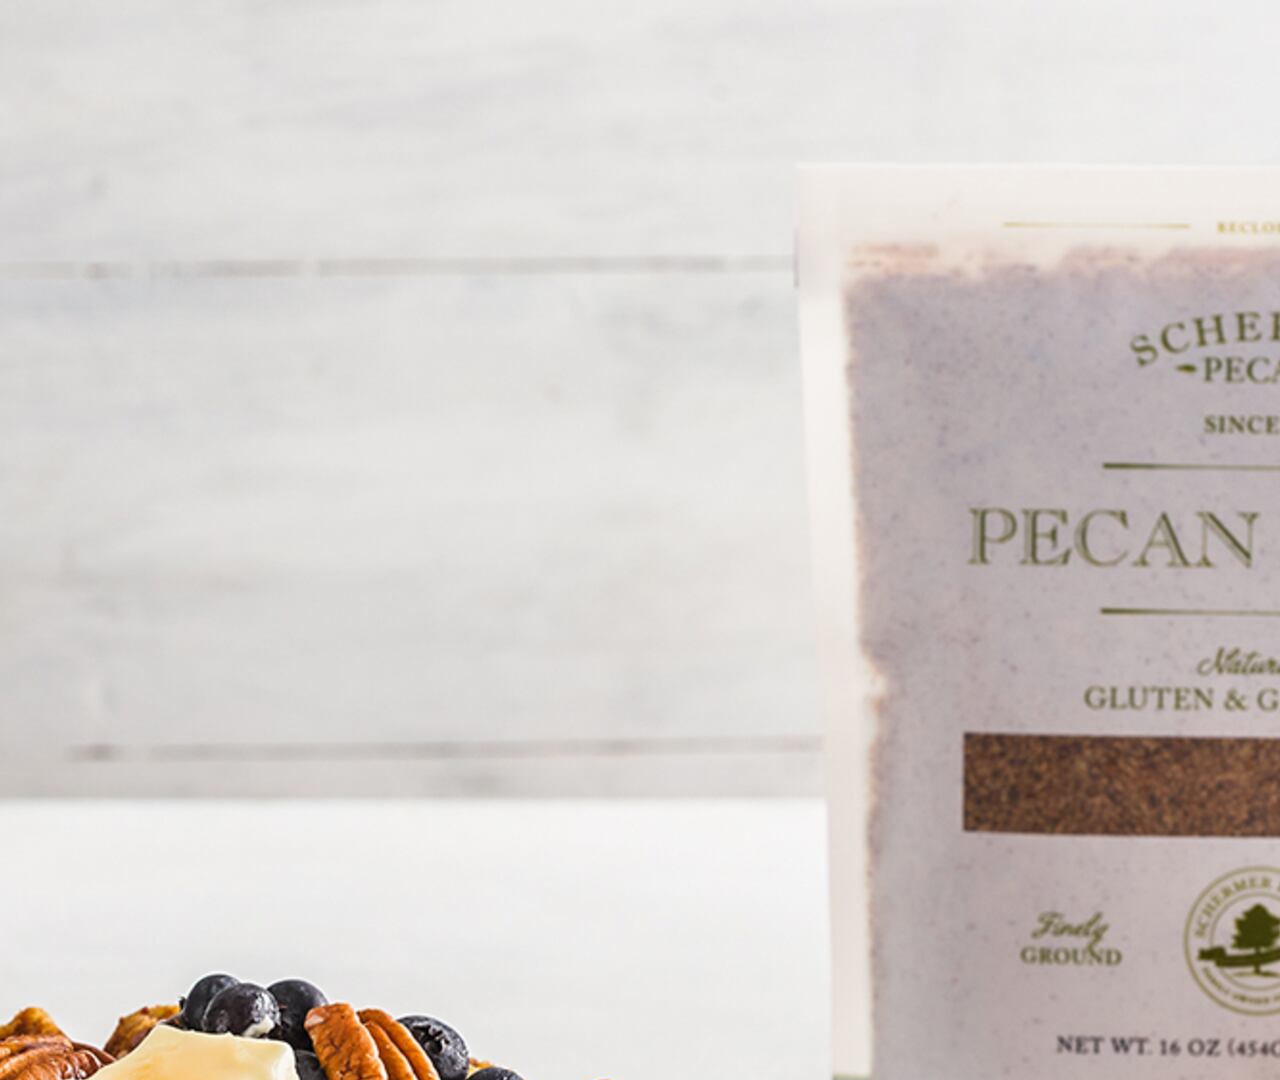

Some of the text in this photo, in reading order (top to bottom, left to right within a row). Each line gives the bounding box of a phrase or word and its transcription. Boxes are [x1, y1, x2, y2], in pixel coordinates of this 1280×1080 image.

[1203, 414, 1280, 436] SINCE
[967, 506, 1261, 569] PECAN
[1082, 684, 1215, 712] GLUTEN
[1223, 686, 1247, 712] &
[1029, 910, 1109, 956] Finely
[1019, 945, 1124, 968] GROUND
[1055, 1034, 1106, 1056] NET
[1109, 1035, 1153, 1057] WT.
[1158, 1037, 1182, 1057] 16
[1186, 1036, 1222, 1058] OZ
